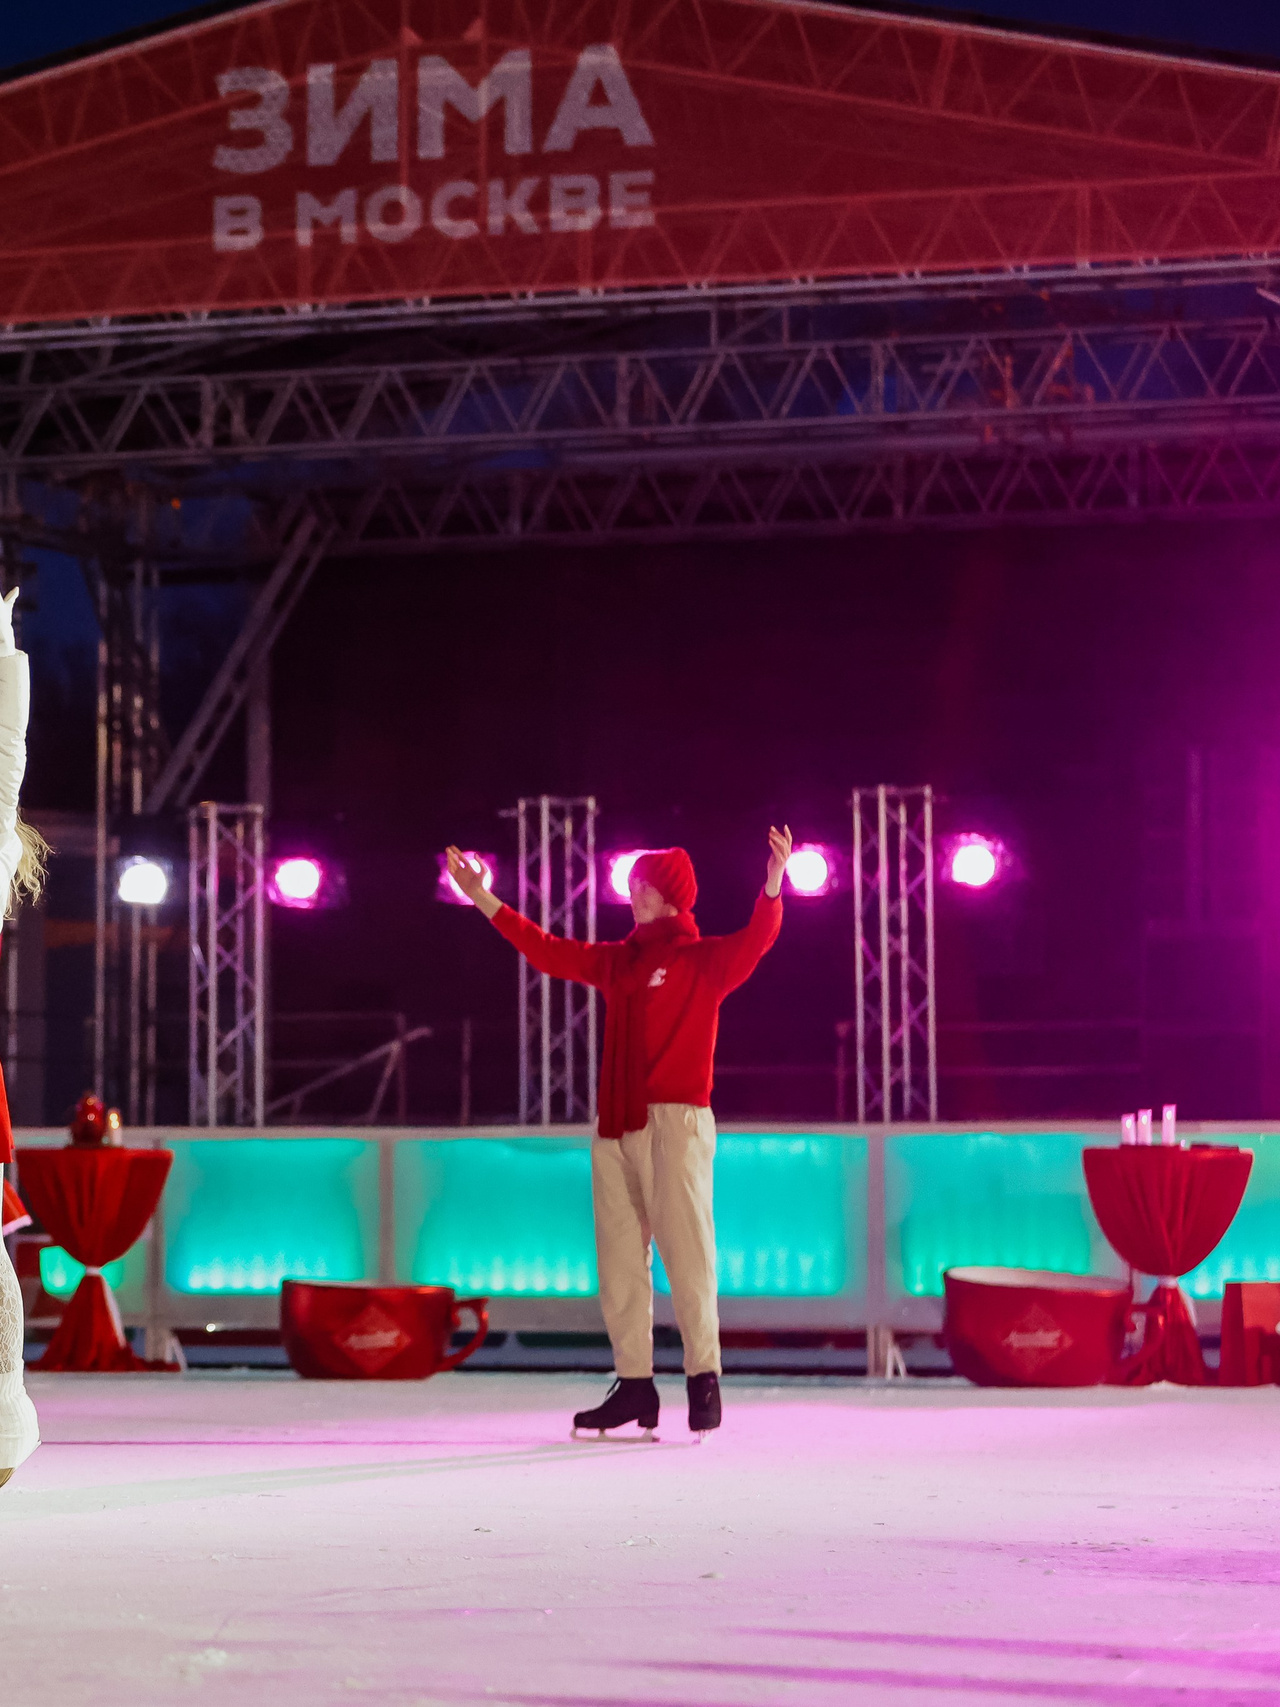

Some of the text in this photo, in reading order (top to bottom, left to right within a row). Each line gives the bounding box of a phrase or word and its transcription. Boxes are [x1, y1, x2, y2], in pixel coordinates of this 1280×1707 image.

[212, 44, 655, 173] ЗИМА
[213, 170, 656, 251] В МОСКВЕ
